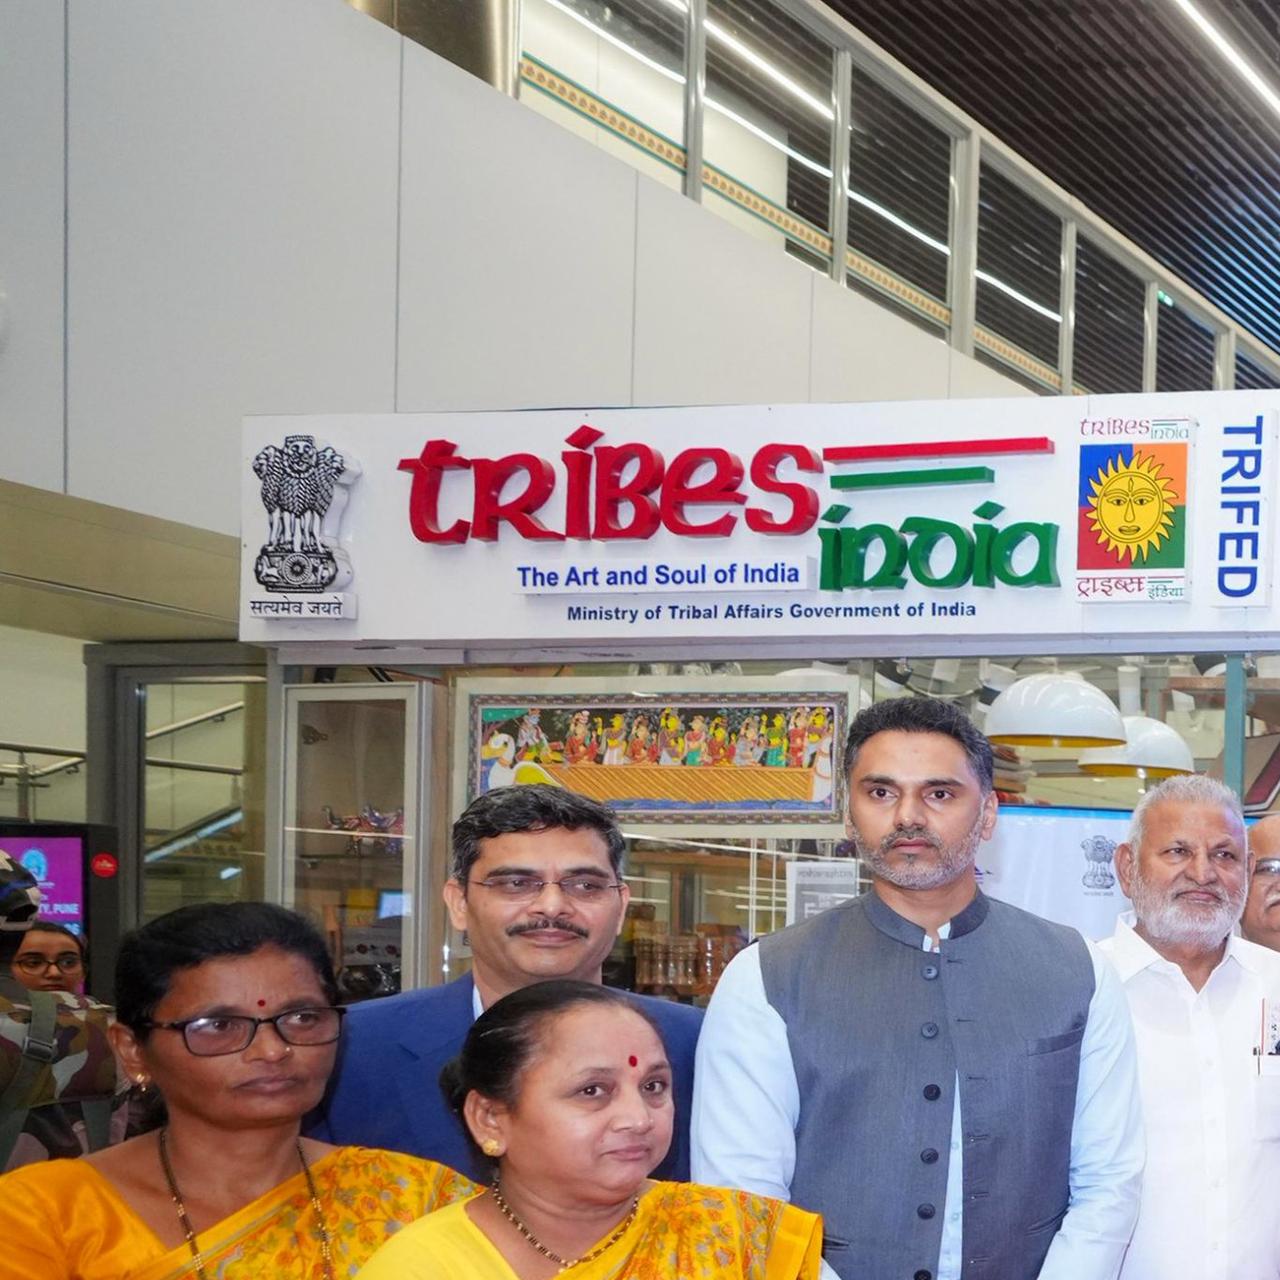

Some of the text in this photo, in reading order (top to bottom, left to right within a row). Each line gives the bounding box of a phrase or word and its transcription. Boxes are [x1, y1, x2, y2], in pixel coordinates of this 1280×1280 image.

[1218, 415, 1264, 598] TRIFED
[517, 562, 800, 588] The Art and Soul of India
[250, 595, 343, 615] सत्यमेव जयते
[567, 601, 976, 623] Ministry of Tribal Affairs Government of India
